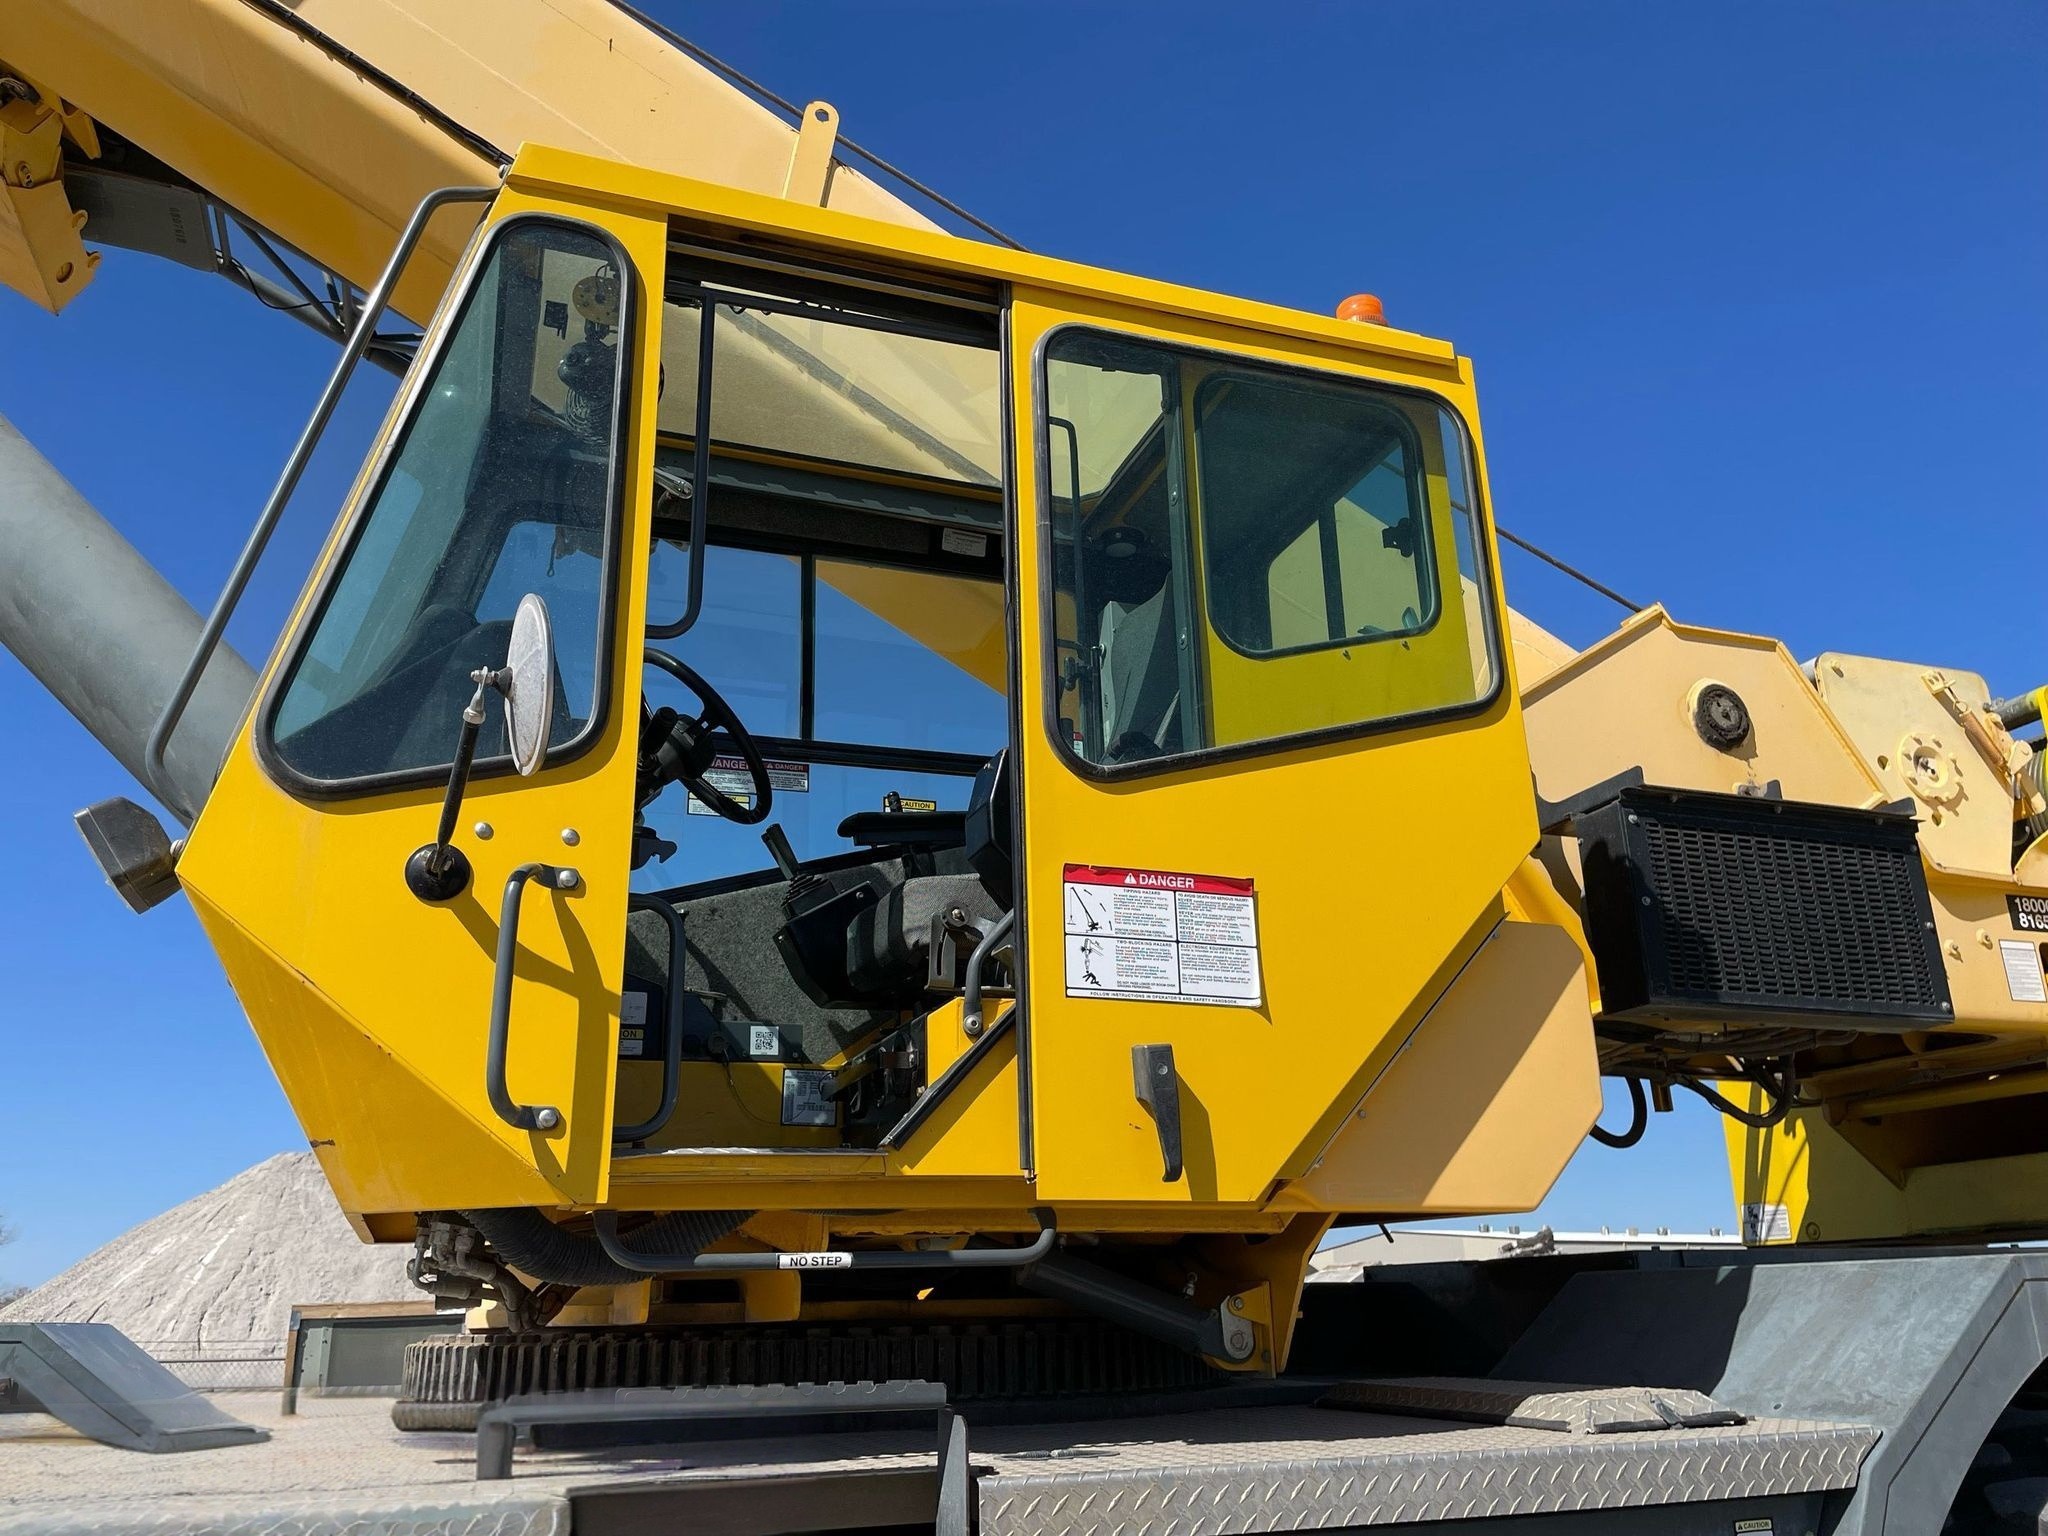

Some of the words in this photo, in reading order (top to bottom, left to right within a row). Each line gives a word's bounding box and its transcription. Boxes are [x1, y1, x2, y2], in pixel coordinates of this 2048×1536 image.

[1139, 874, 1194, 888] DANGER
[790, 1257, 808, 1267] NO
[811, 1256, 843, 1266] STEP
[1743, 1521, 1770, 1529] CAUTION
